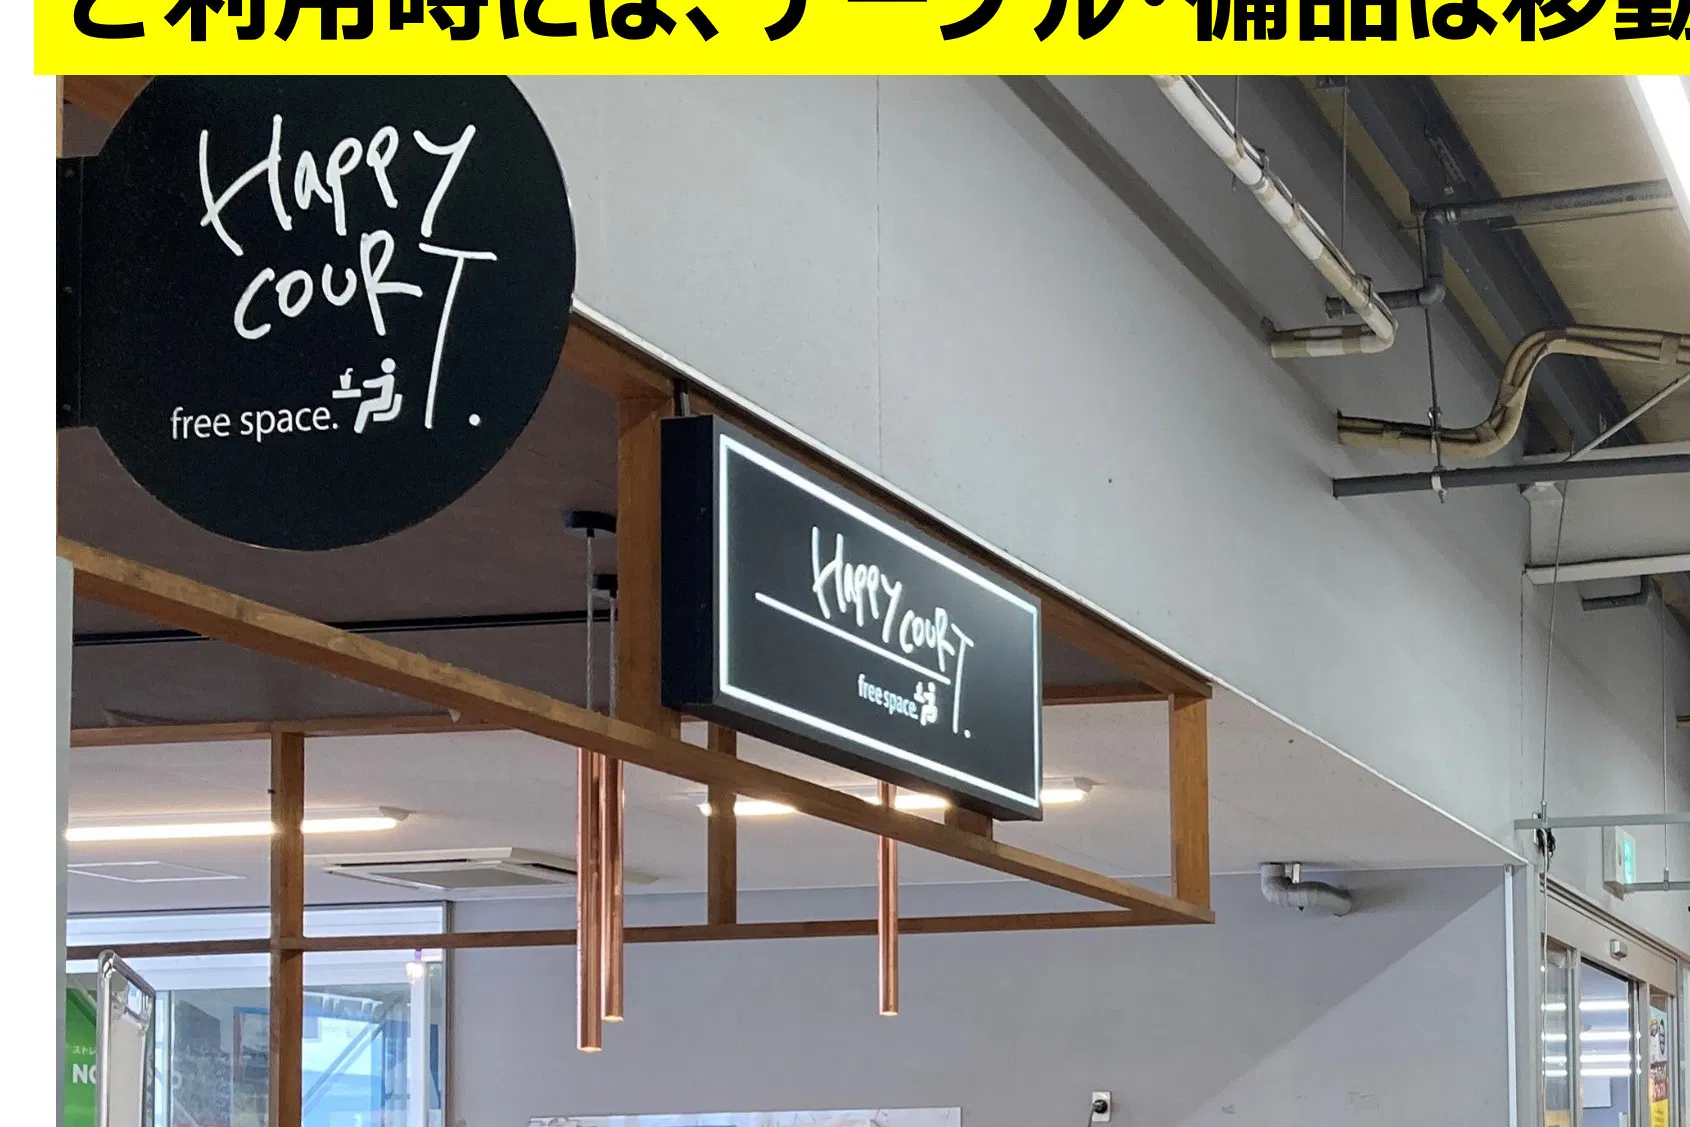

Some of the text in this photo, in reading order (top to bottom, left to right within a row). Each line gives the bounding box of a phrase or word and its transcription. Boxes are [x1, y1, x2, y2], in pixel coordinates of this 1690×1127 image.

[170, 405, 339, 443] free space.
[857, 673, 918, 721] free space.
